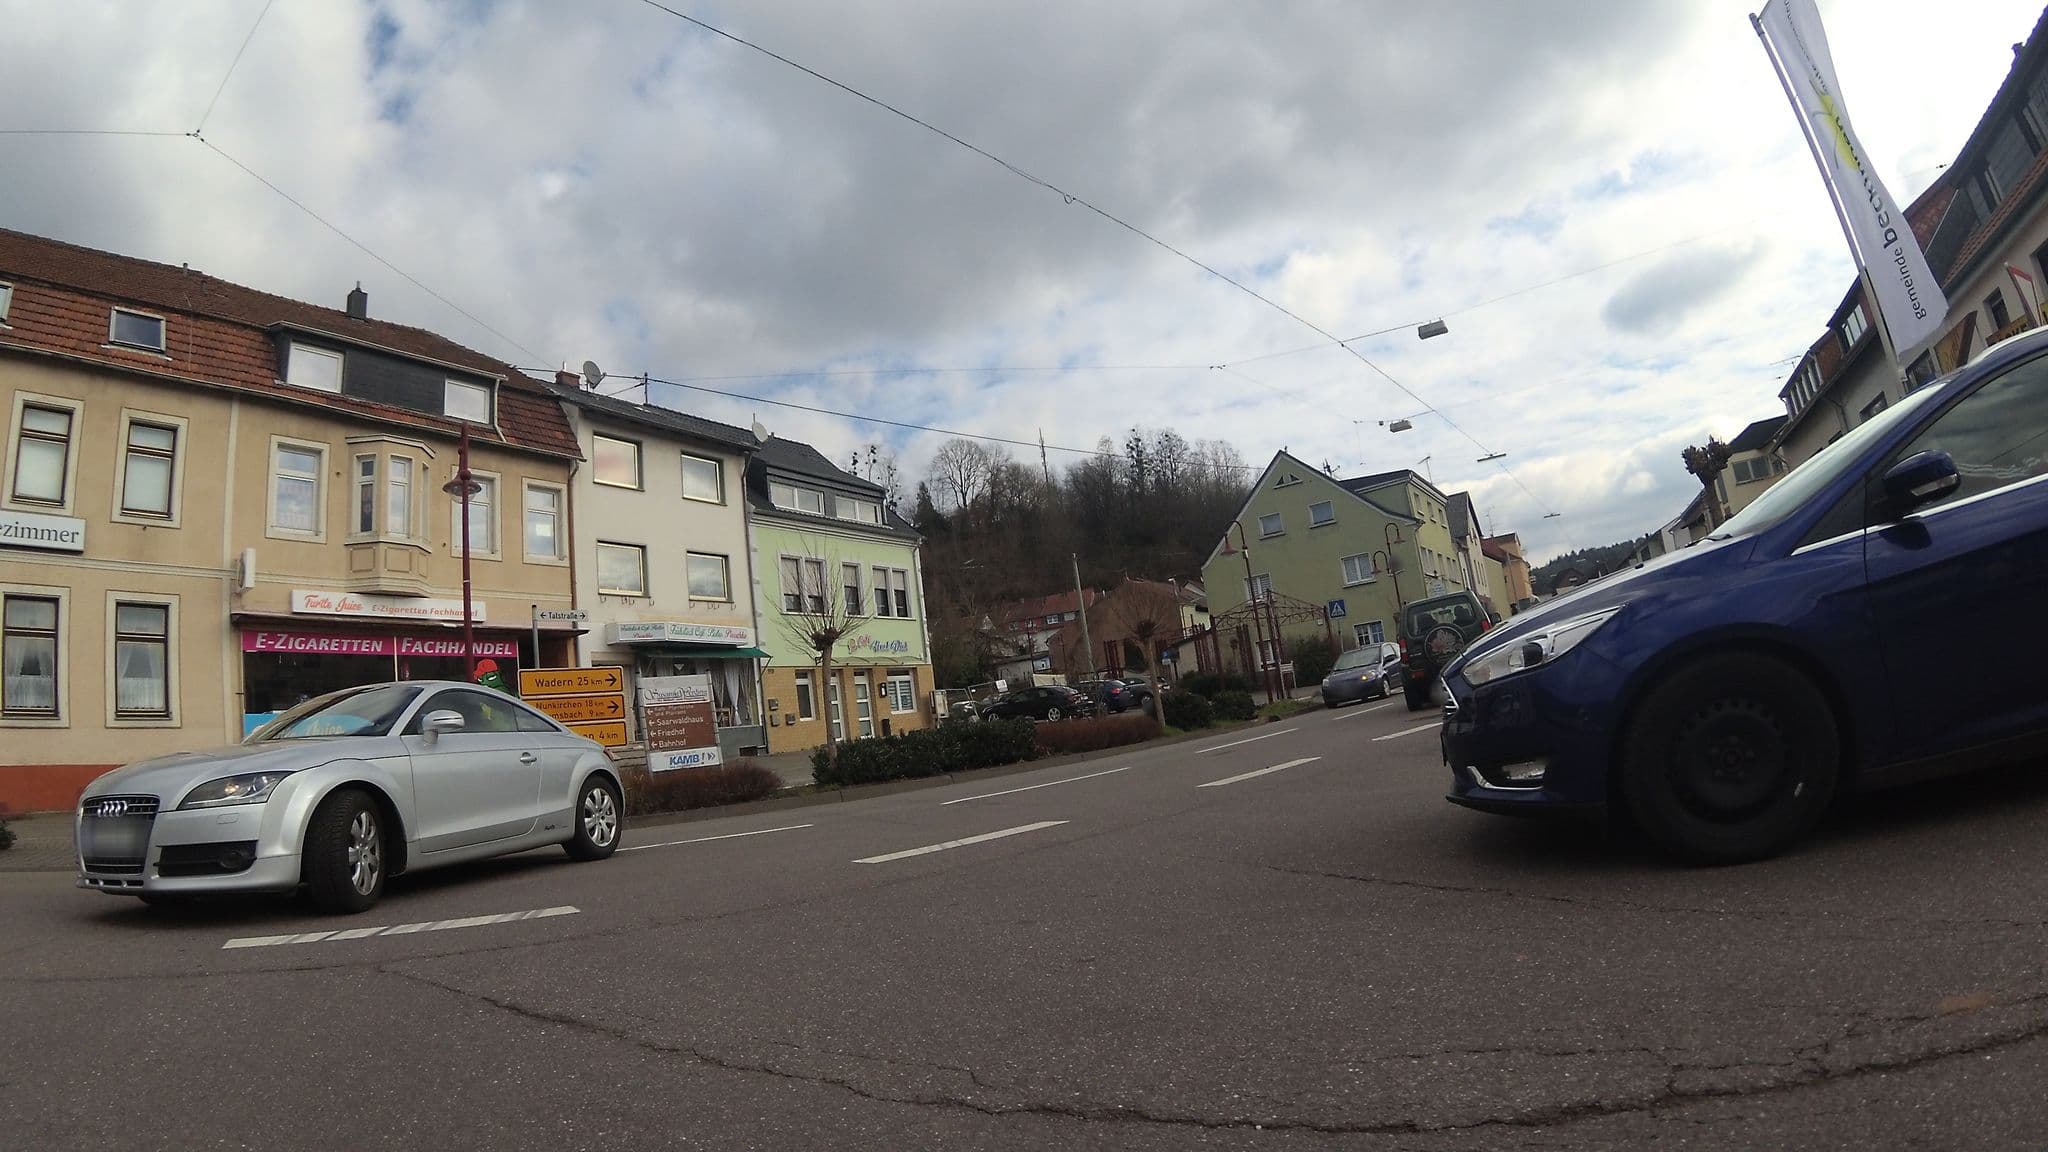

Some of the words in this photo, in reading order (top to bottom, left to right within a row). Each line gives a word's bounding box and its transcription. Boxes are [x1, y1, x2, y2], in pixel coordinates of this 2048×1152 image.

[1894, 247, 1927, 320] gemeinde
[0, 521, 80, 543] zimmer
[372, 604, 428, 614] E-Zigaretten
[430, 607, 478, 617] Fachhanel
[549, 611, 578, 619] Talstraße
[255, 632, 383, 652] E-ZIGARETTEN
[535, 678, 573, 688] Wadern
[577, 676, 589, 686] 25
[591, 678, 603, 686] km
[535, 700, 582, 710] Nunkirchen
[586, 699, 593, 707] 18
[589, 709, 594, 717] 9
[657, 716, 704, 726] Saarwaldhaus
[598, 731, 605, 739] 4
[657, 727, 685, 737] Friedhof
[659, 738, 687, 748] Bahnhof
